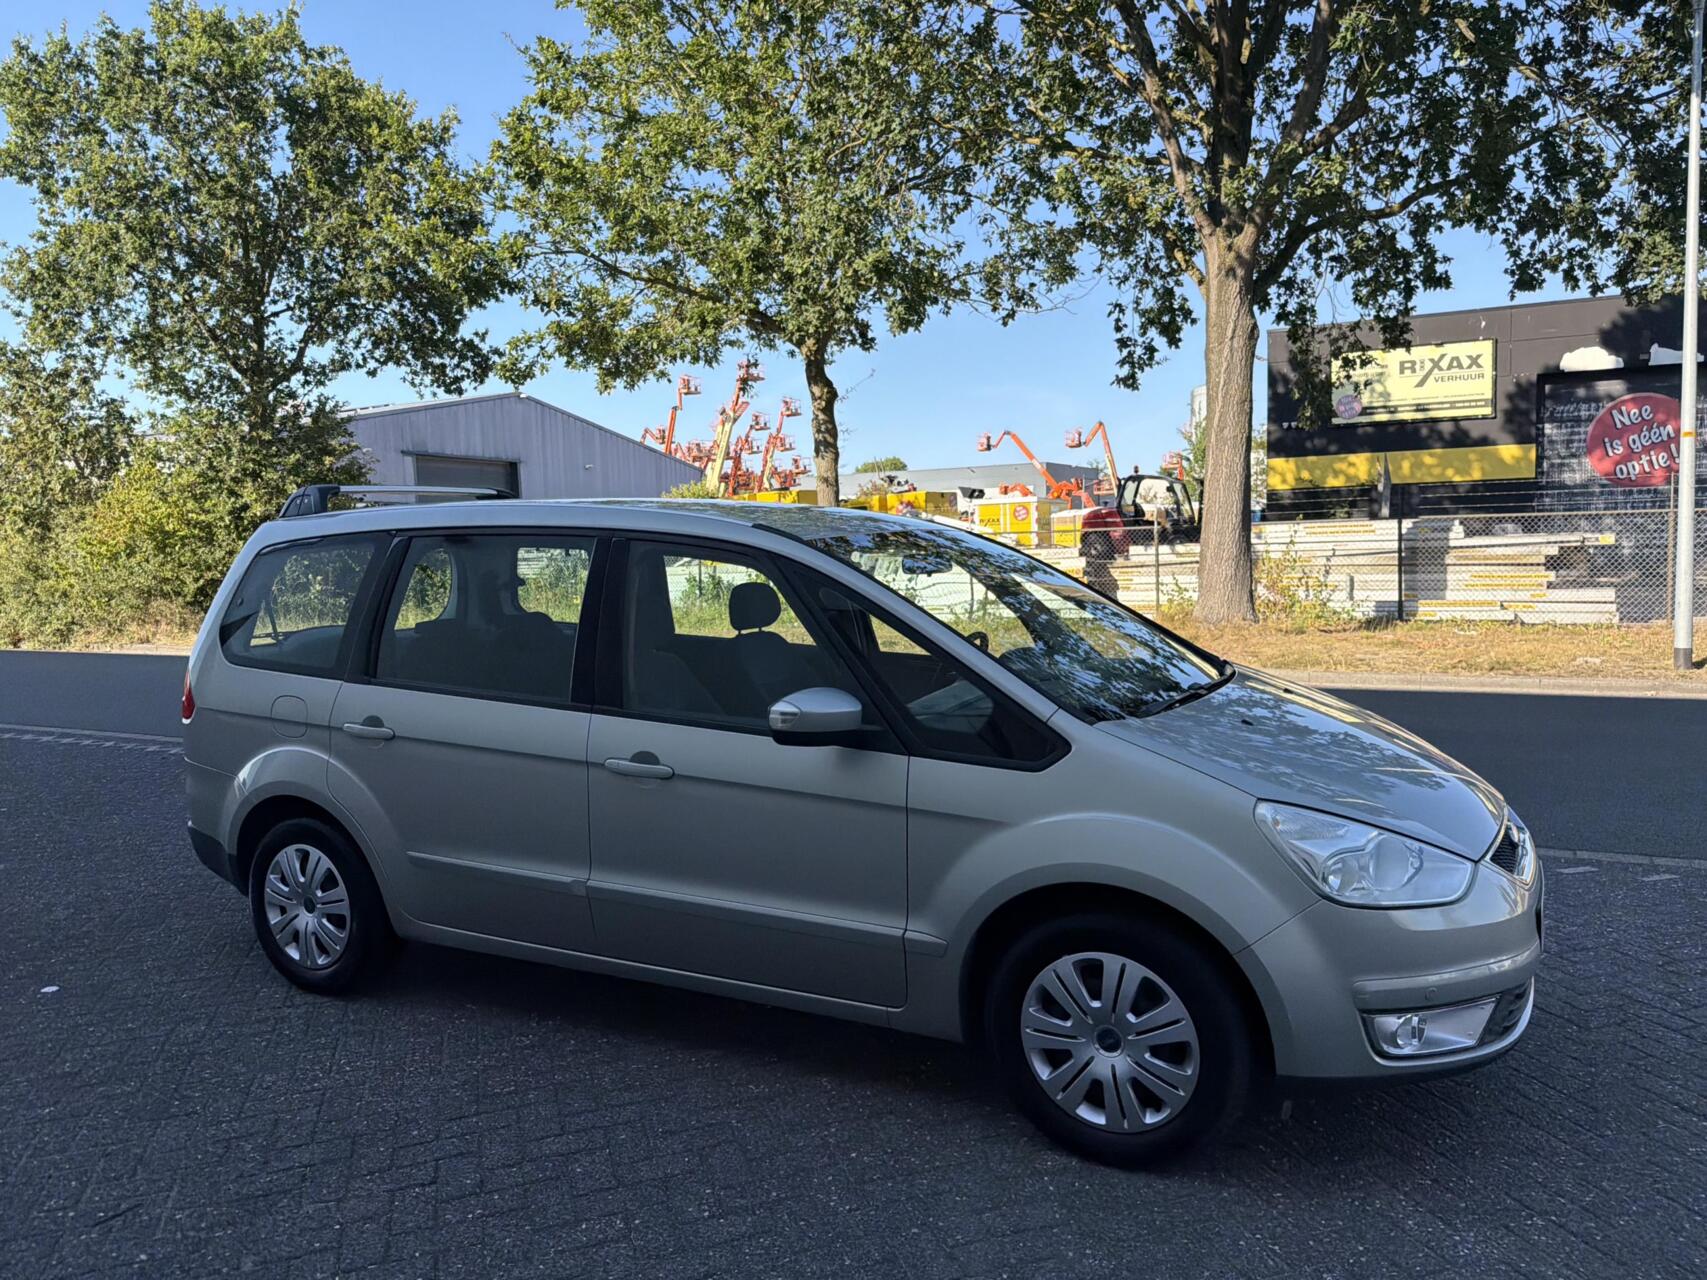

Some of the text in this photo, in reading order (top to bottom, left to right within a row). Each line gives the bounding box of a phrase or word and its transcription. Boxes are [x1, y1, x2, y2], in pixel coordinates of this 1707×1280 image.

[1434, 373, 1485, 383] VERHUUR
[1611, 405, 1653, 429] Nee
[1604, 423, 1675, 457] is géén
